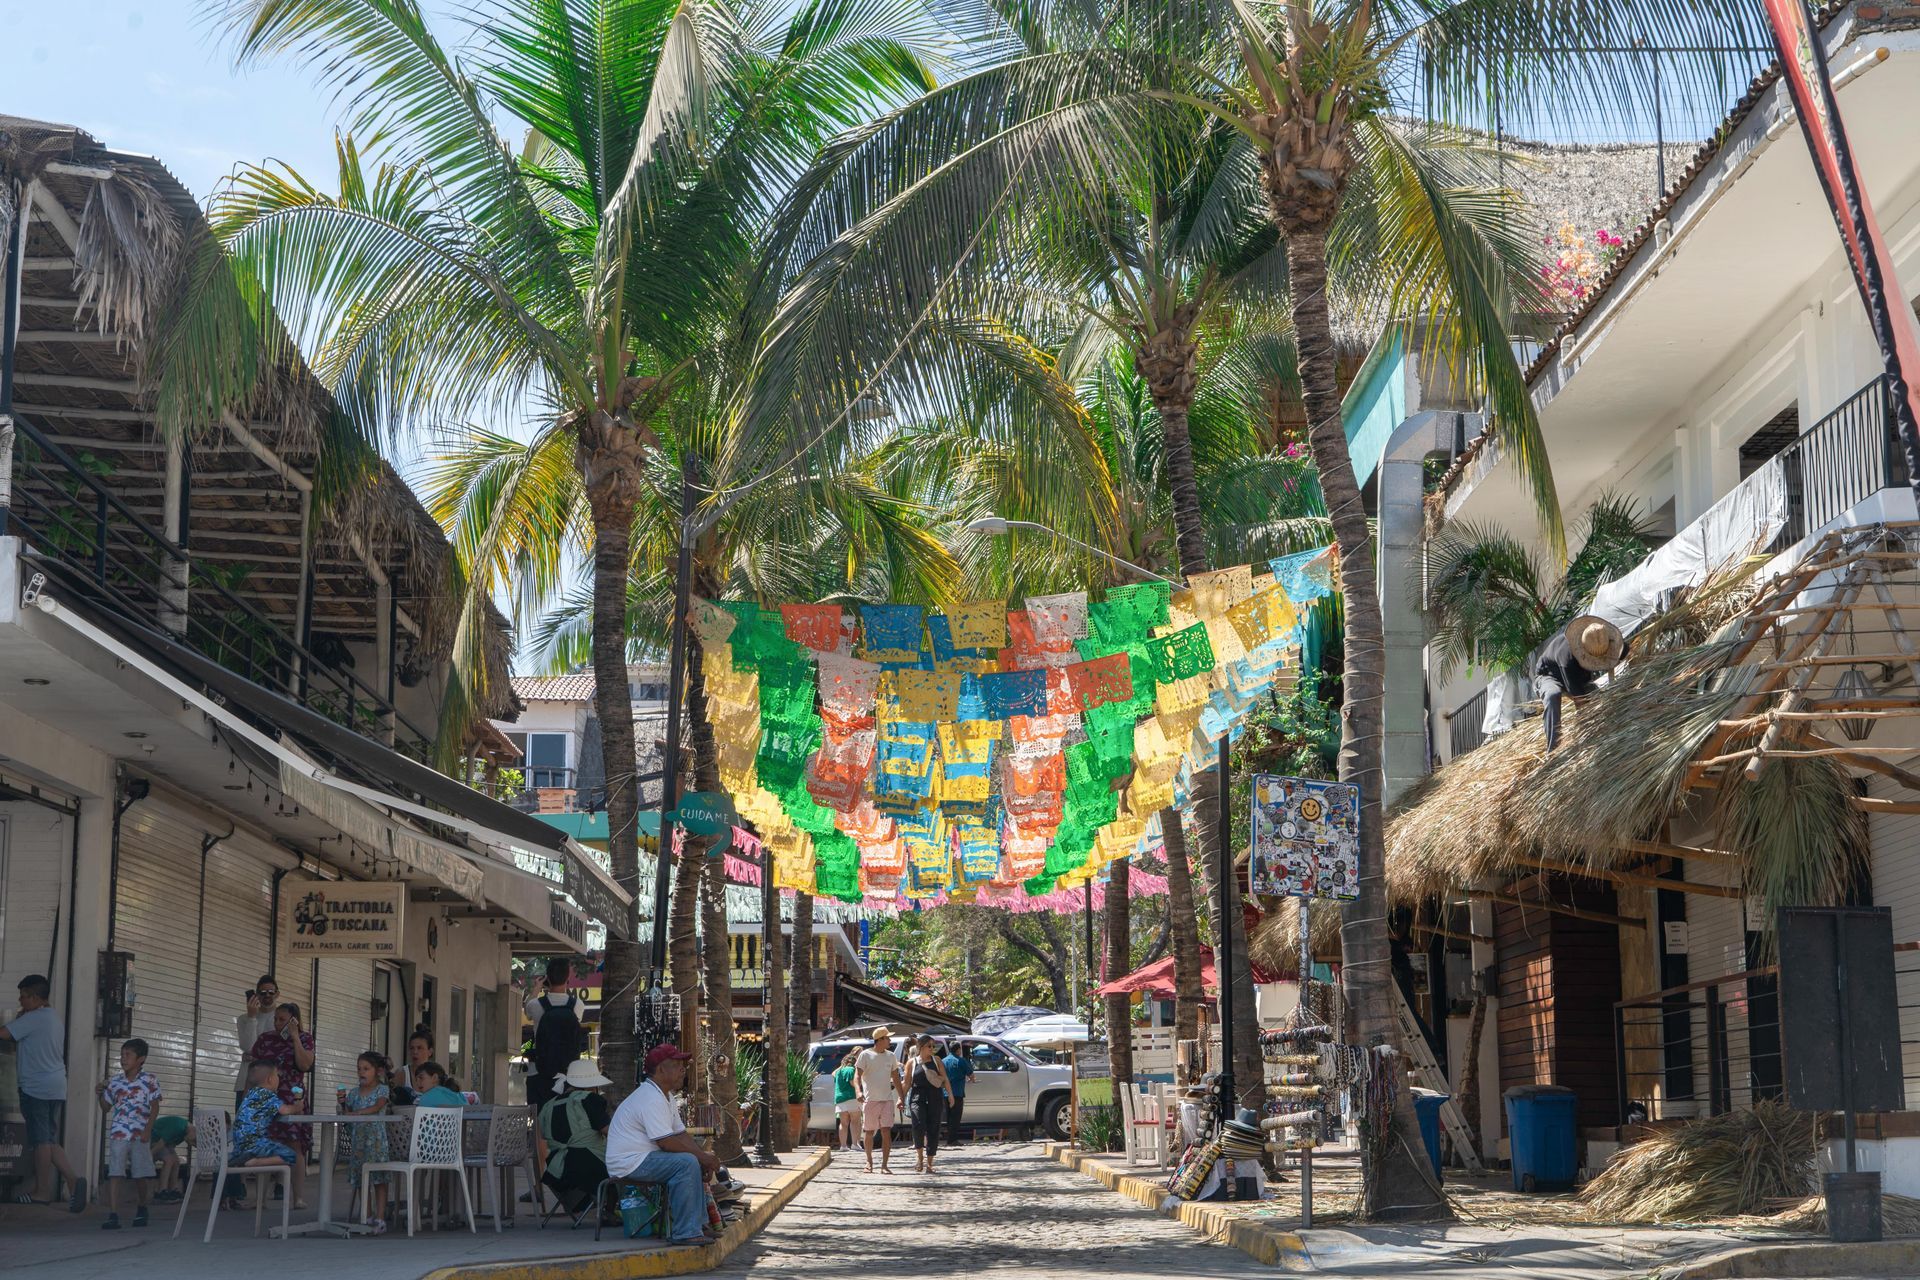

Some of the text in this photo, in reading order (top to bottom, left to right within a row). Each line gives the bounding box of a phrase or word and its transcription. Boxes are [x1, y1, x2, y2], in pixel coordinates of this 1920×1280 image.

[680, 808, 729, 824] CUIDAME
[325, 901, 394, 914] TRATTORIA
[331, 918, 388, 931] TOSCANA
[320, 942, 342, 950] PASTA
[347, 942, 371, 950] CARNE
[375, 942, 394, 950] VINO
